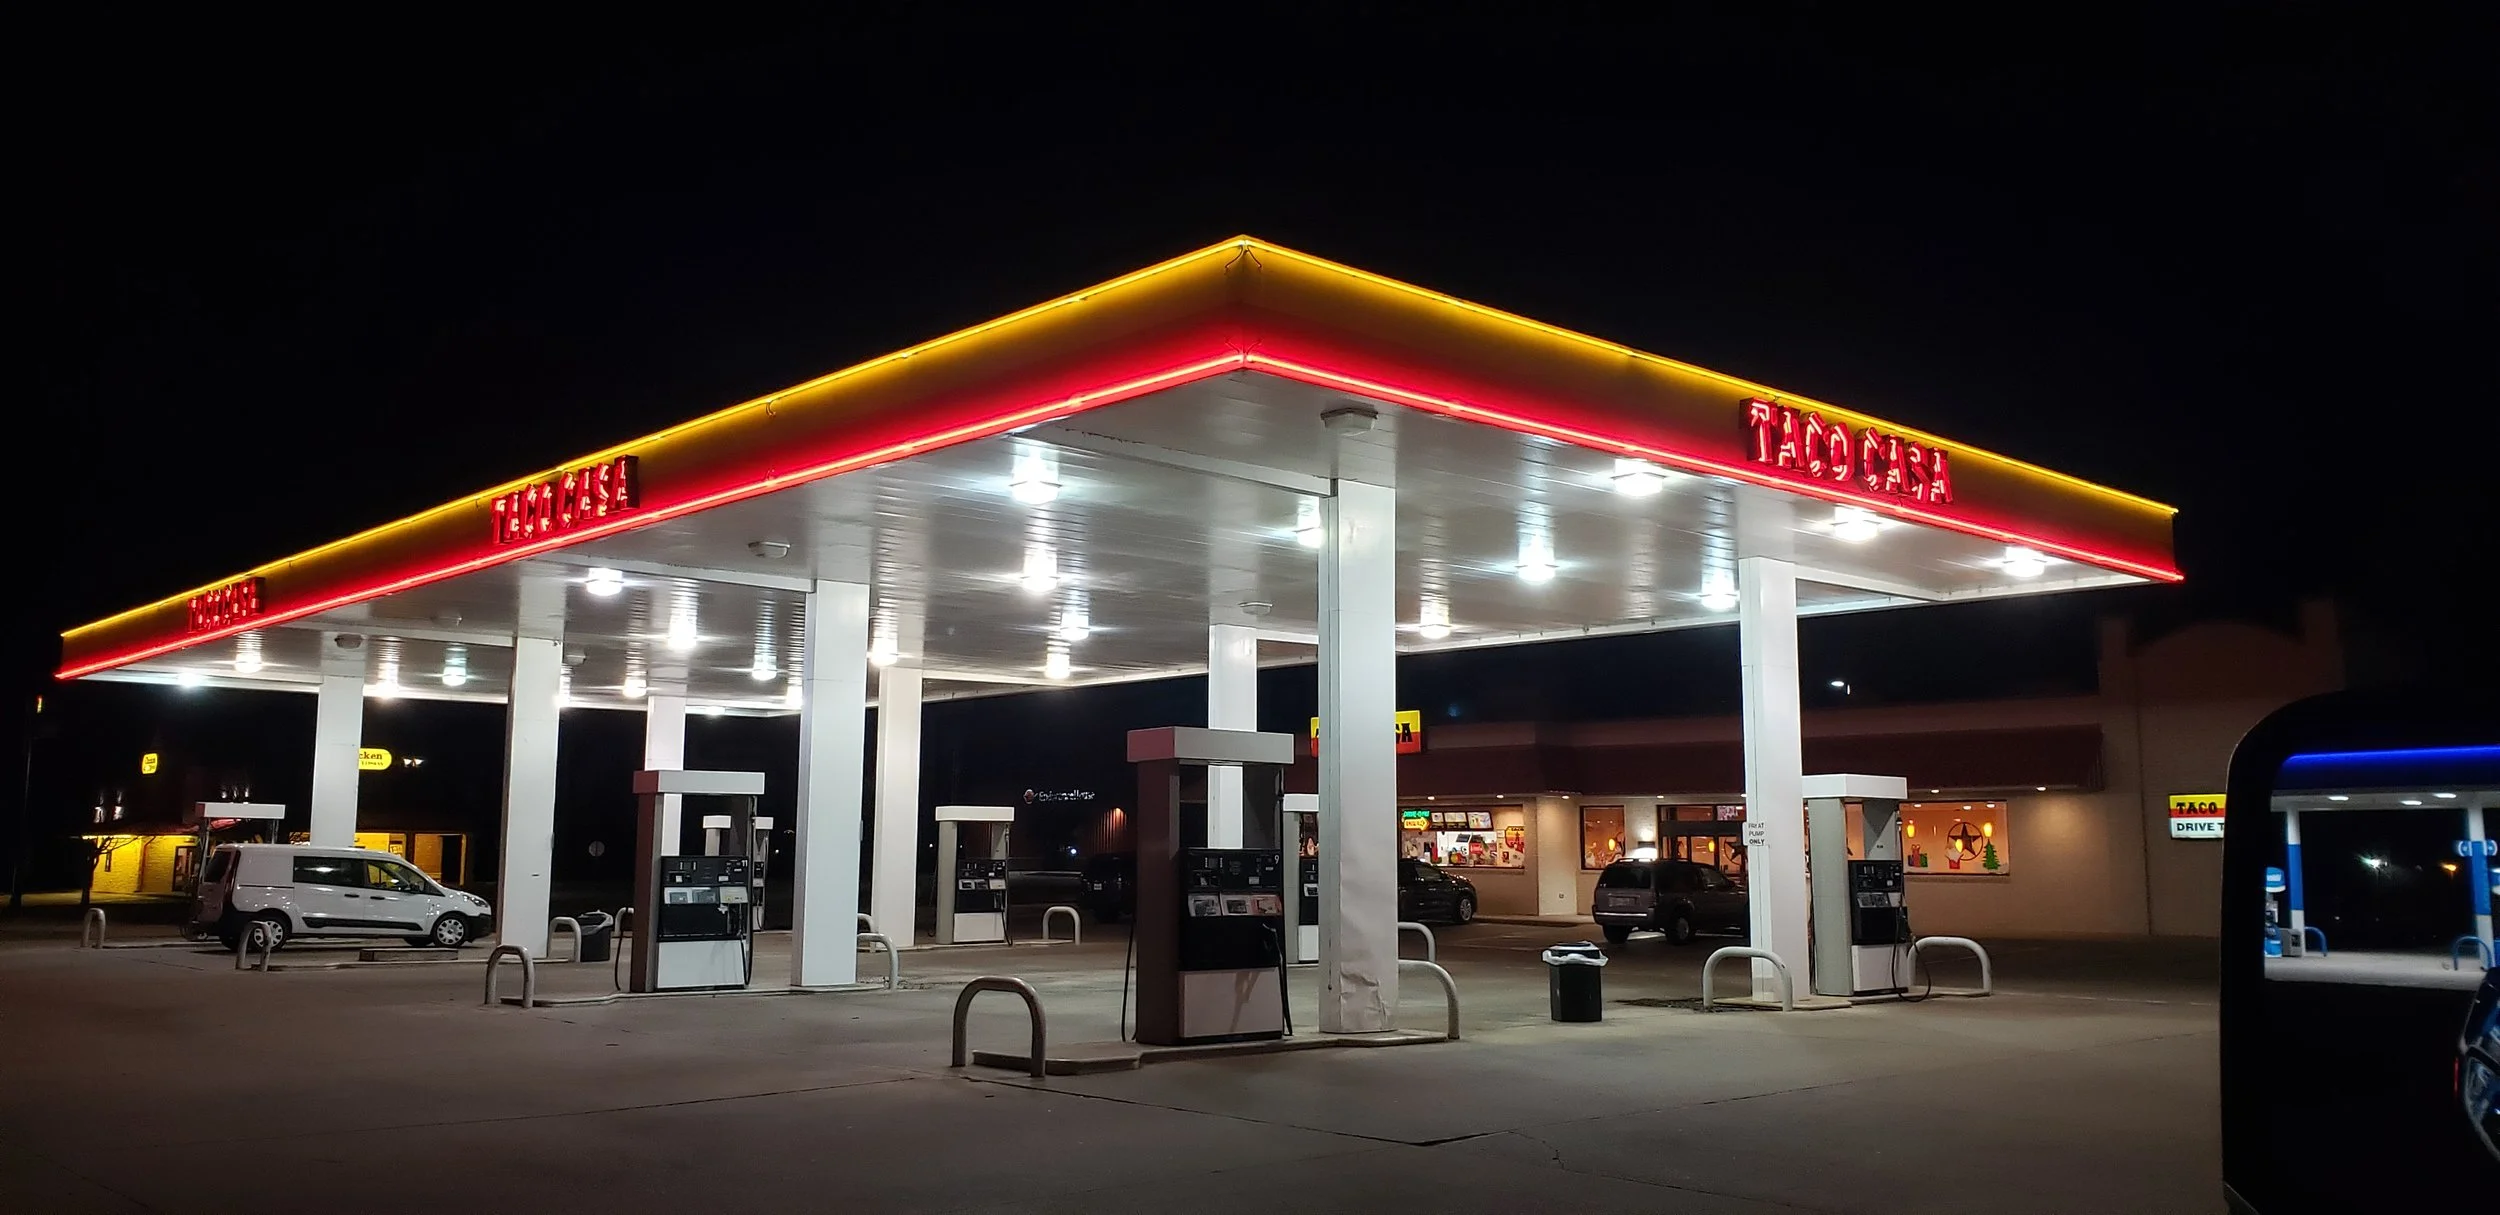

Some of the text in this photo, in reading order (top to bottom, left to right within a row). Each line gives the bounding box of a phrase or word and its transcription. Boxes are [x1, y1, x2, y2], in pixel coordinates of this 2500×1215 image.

[1740, 397, 1954, 504] TACO CASA
[491, 455, 639, 545] TACO CASA
[2176, 802, 2218, 814] TACO
[2177, 822, 2215, 831] DRIVE
[1274, 854, 1280, 865] 9
